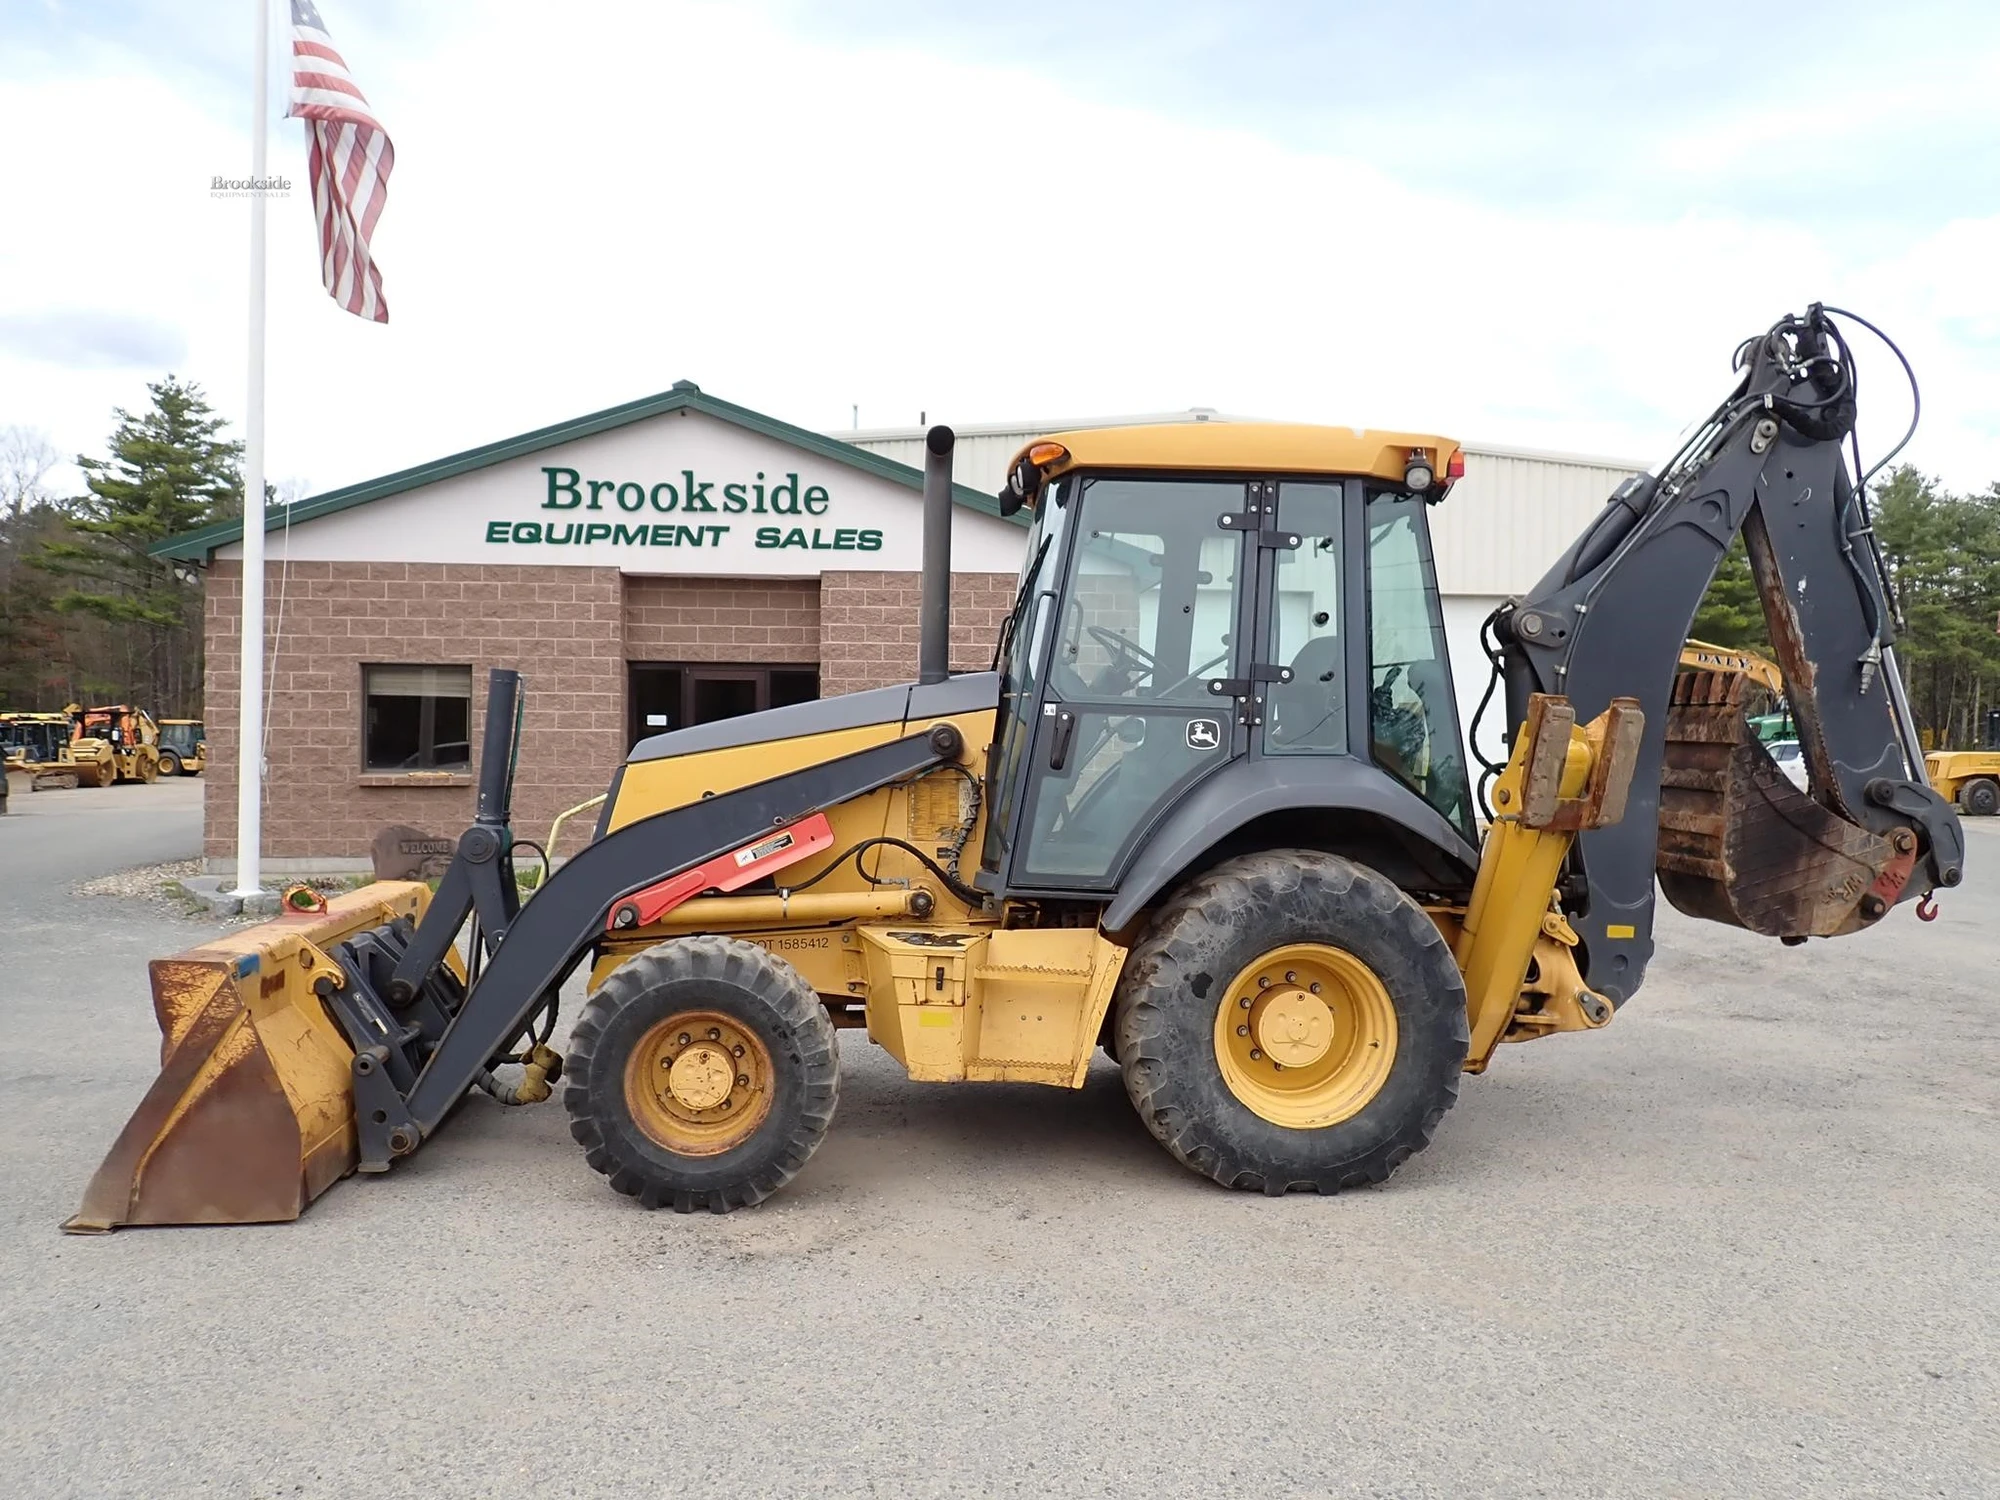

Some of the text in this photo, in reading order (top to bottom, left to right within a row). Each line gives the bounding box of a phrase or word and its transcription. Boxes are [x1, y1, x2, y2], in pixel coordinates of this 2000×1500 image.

[540, 466, 830, 516] Brookside
[485, 520, 884, 552] EQUIPMENT SALES
[400, 841, 449, 854] WELCOME
[748, 936, 830, 950] OT 1585412
